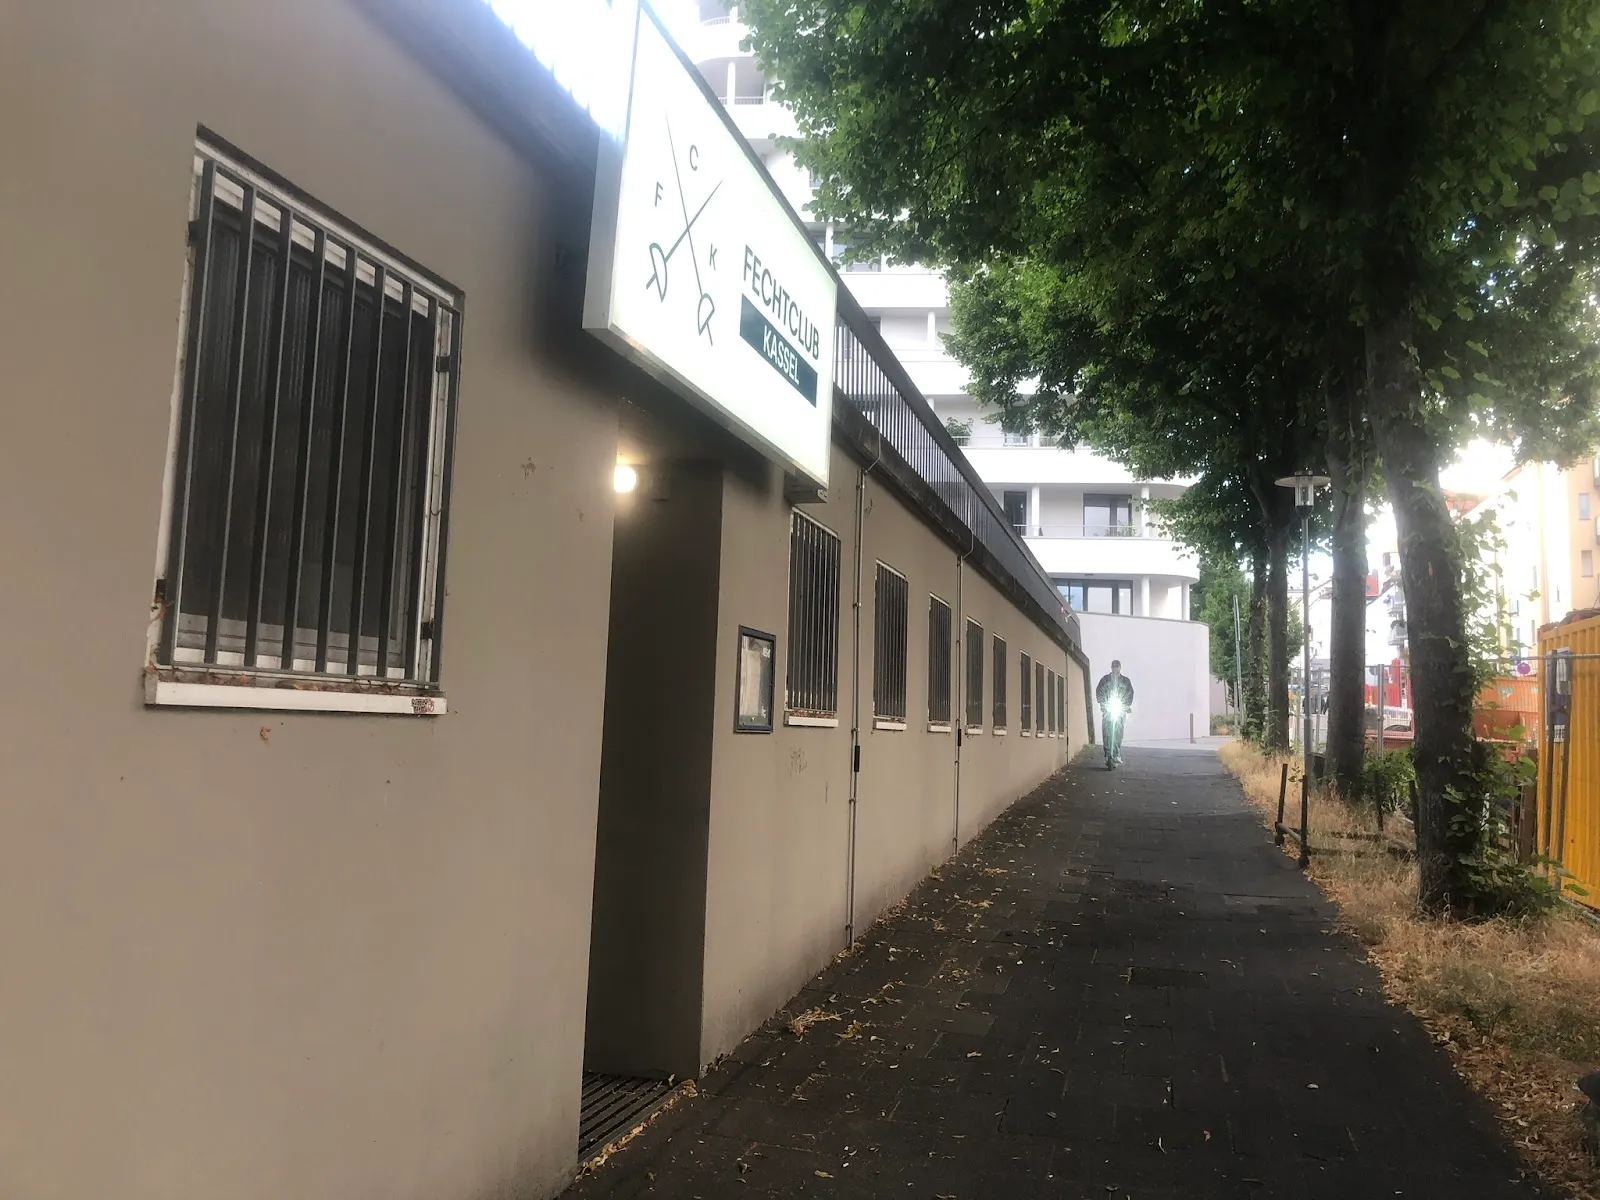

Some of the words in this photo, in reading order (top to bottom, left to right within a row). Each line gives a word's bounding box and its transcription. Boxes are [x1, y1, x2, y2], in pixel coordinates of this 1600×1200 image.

[689, 144, 699, 171] C
[654, 180, 664, 207] F
[708, 243, 718, 272] K
[743, 243, 820, 361] FECHTCLUB
[763, 324, 800, 386] KASSEL
